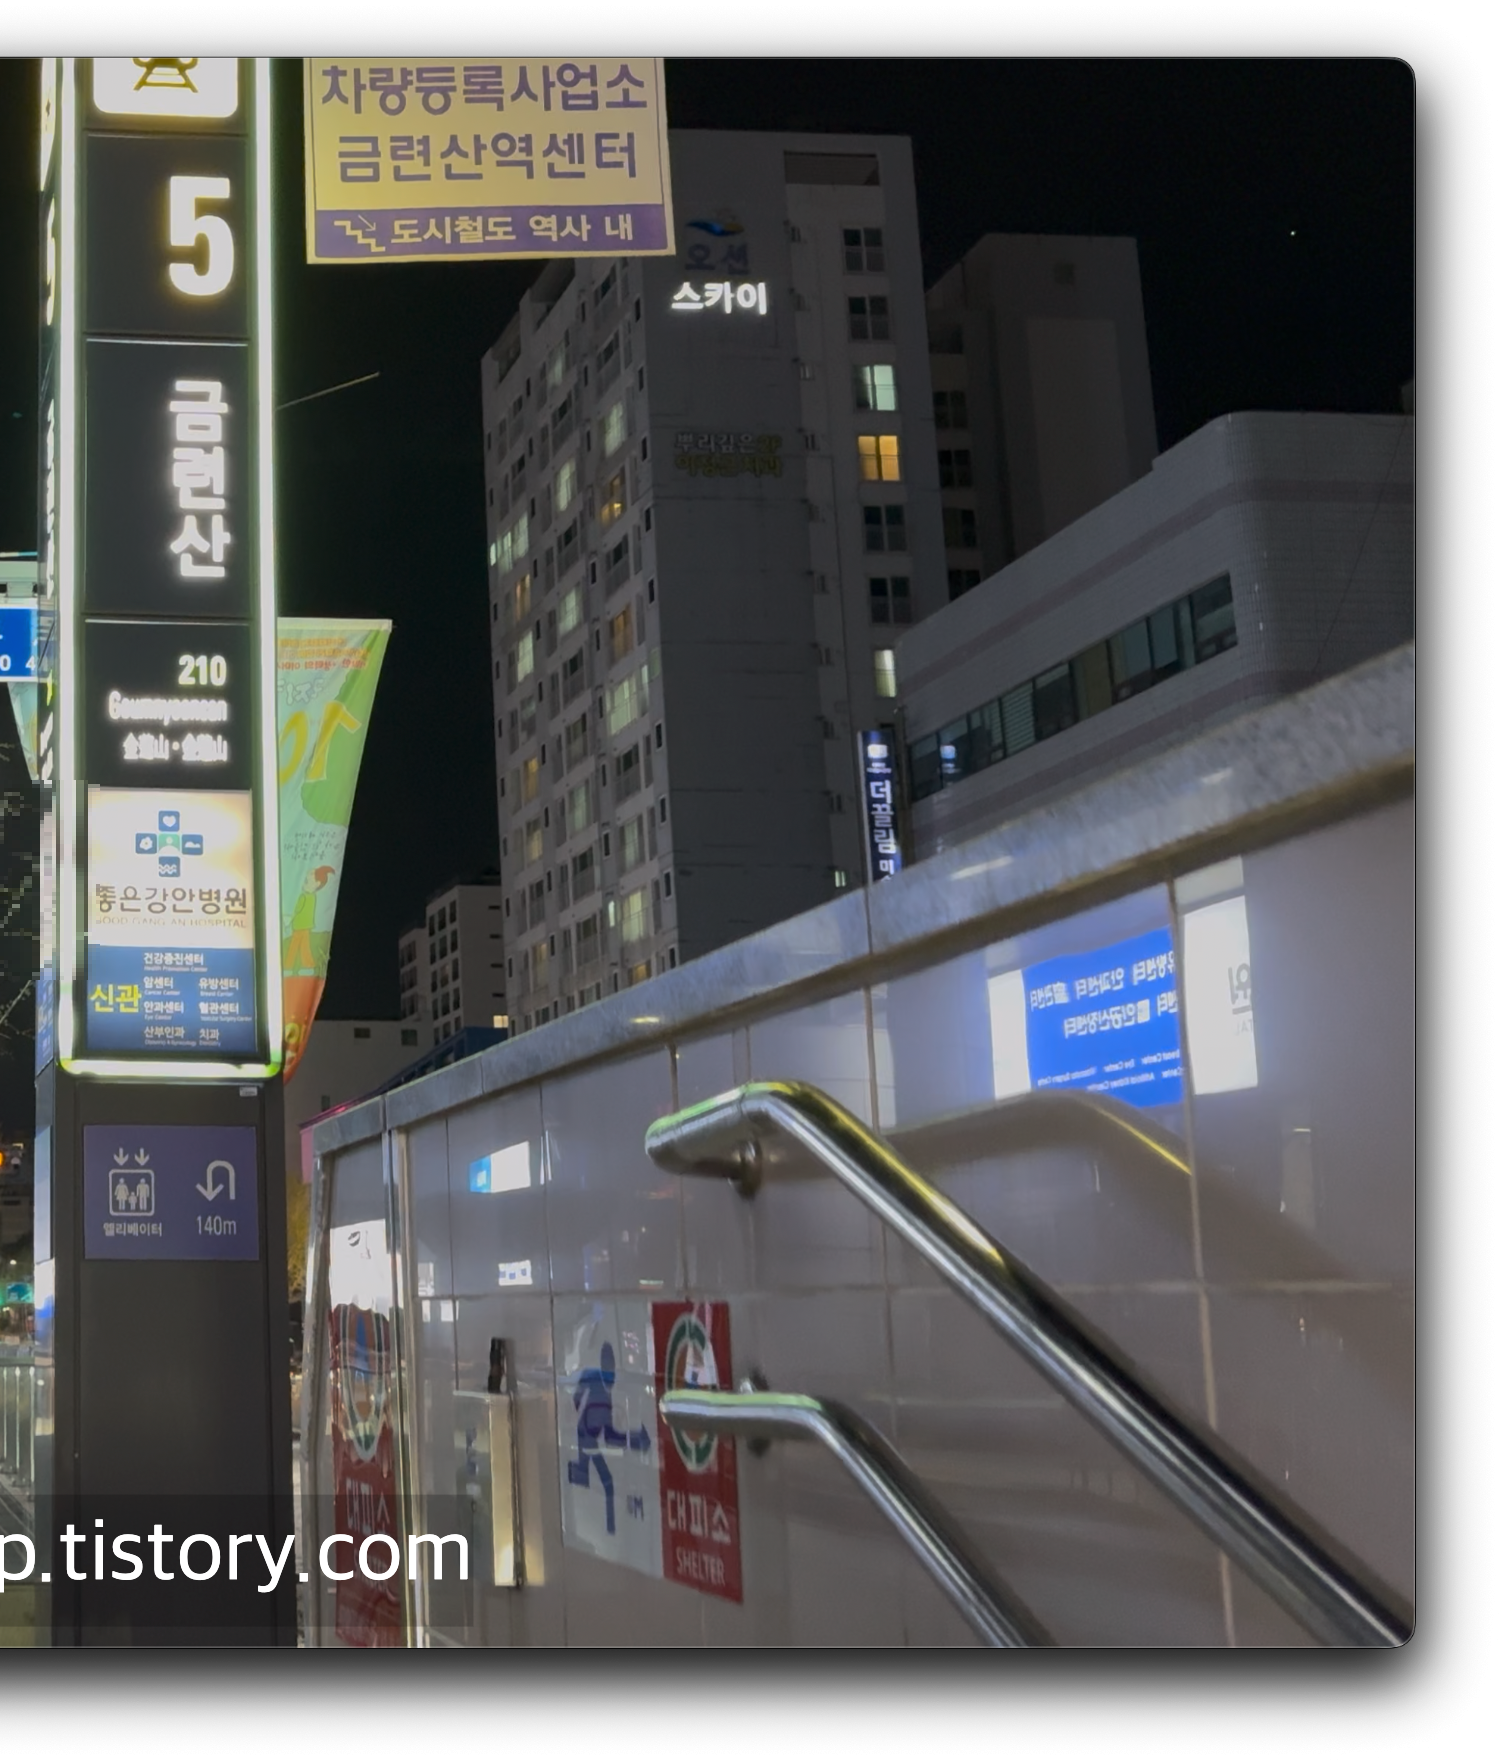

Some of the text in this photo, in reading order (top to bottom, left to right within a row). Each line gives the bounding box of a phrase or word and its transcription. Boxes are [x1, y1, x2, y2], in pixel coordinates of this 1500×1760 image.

[321, 63, 648, 116] 차량등록사업소
[338, 131, 637, 183] 금련산역센터
[168, 175, 235, 297] 5
[391, 213, 634, 245] 도시철도 역사 내
[671, 281, 768, 315] 스카이
[169, 380, 231, 578] 금련산
[178, 654, 228, 687] 210
[96, 884, 248, 915] 좋은강안병원
[190, 917, 247, 929] HOSPITAL
[143, 952, 204, 966] 건강증진센터
[90, 983, 142, 1014] 신관
[143, 976, 239, 991] 암센터 유방센터
[143, 1000, 184, 1014] 안과센터
[143, 1026, 220, 1041] 산부인과 치과
[103, 1215, 237, 1237] 엘리베이터 140m
[665, 1488, 732, 1545] 대피소
[674, 1547, 726, 1587] SHELTER
